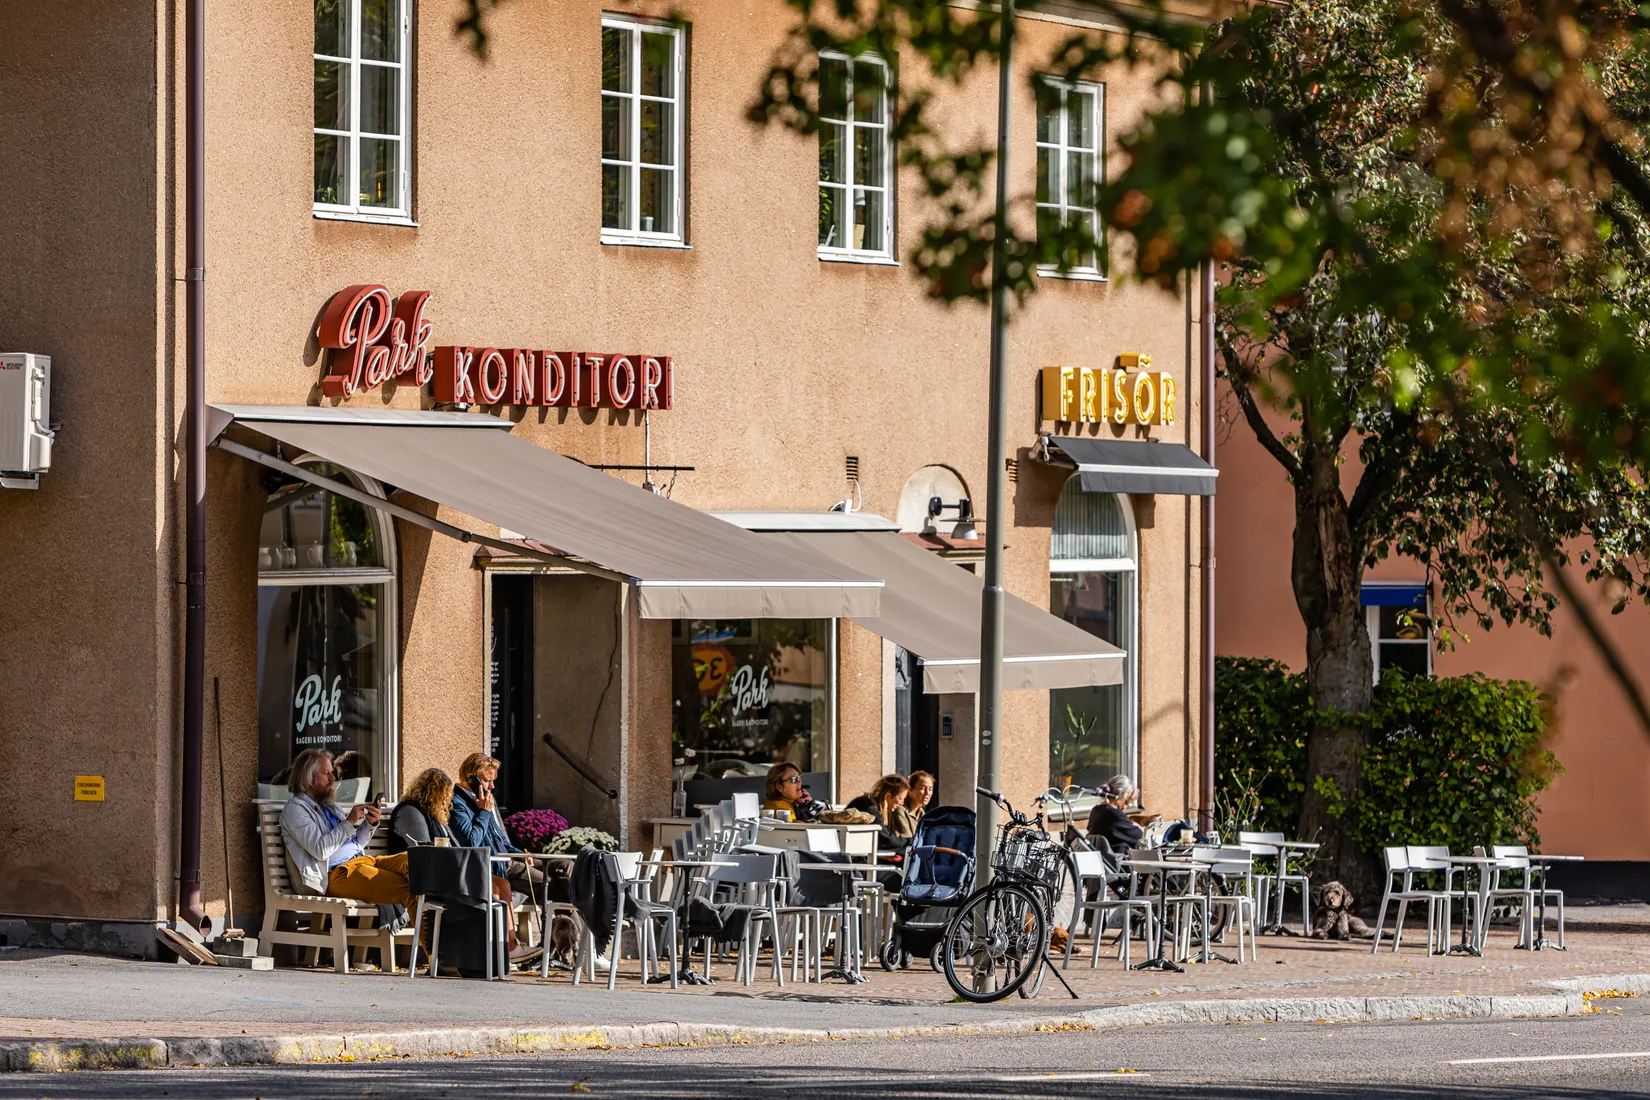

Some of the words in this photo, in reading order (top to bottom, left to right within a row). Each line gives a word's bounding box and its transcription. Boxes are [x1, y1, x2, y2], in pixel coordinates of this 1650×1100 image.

[319, 284, 433, 398] Park
[450, 347, 675, 410] KONDITORI
[1060, 353, 1176, 426] FRISÖR
[295, 674, 342, 732] Park
[731, 664, 769, 716] Park
[317, 735, 342, 743] KONDITORI
